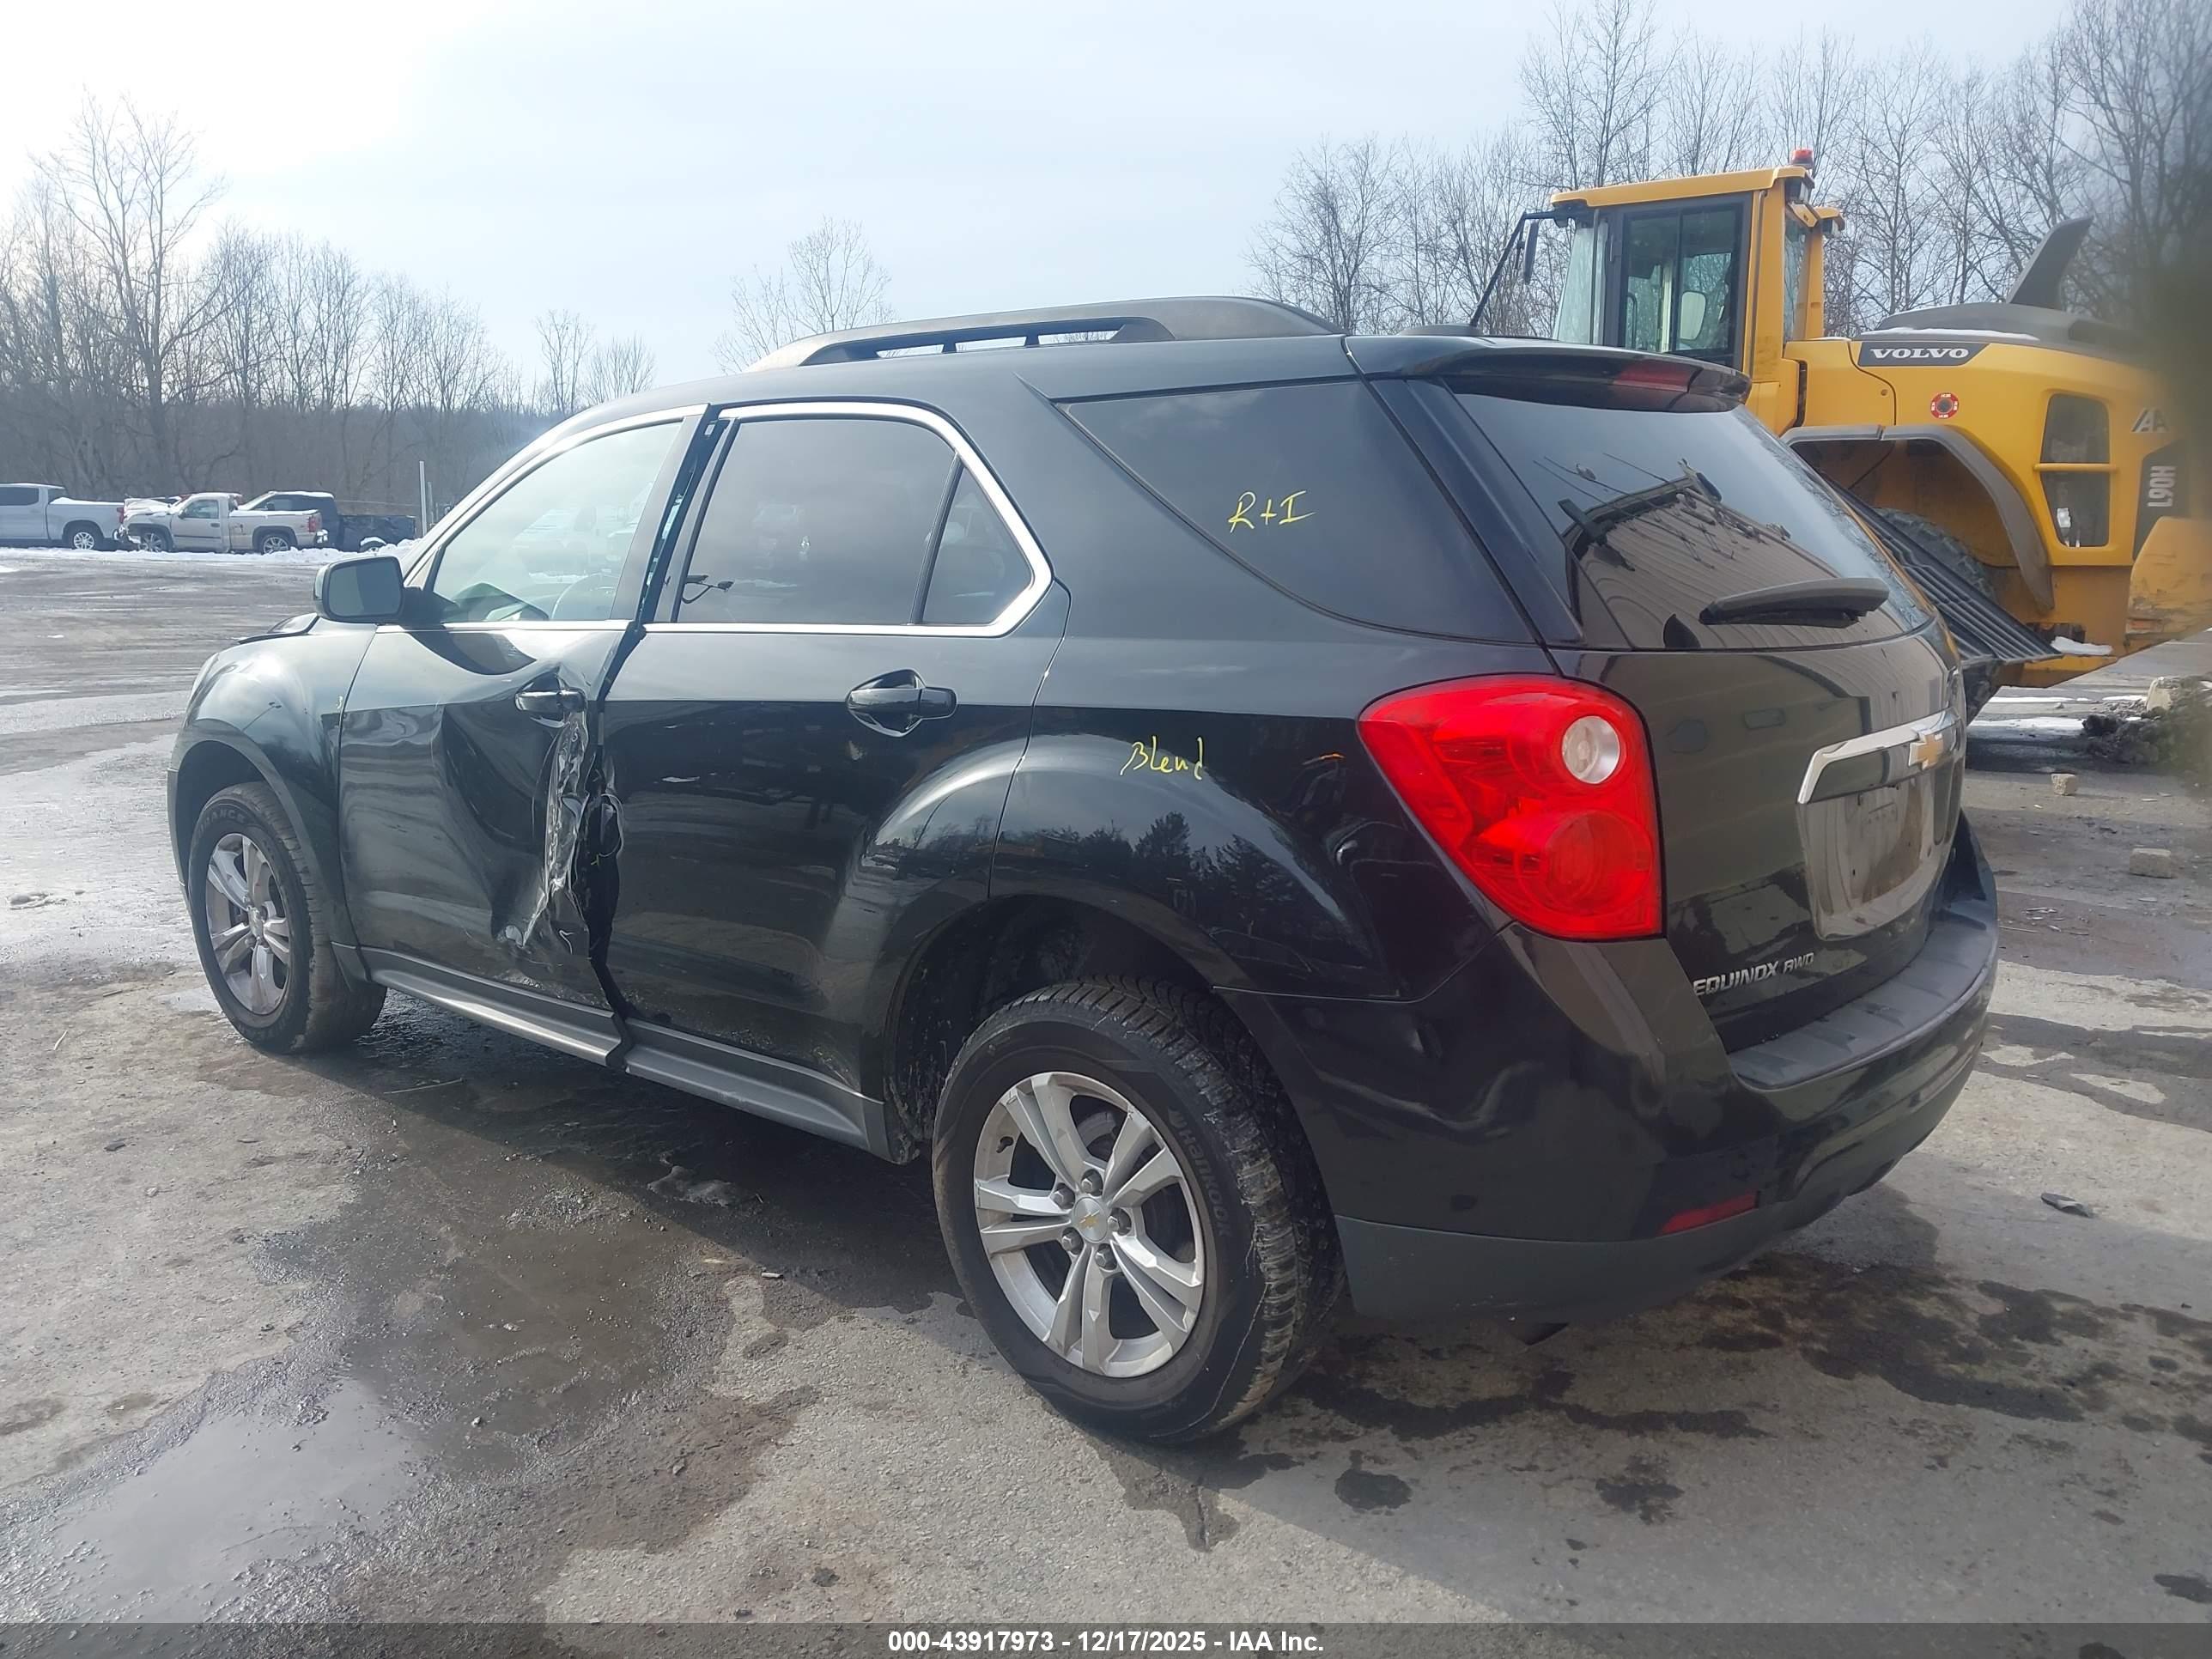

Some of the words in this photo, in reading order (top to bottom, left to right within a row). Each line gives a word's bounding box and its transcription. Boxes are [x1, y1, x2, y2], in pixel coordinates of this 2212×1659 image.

[1870, 348, 1969, 359] VOLVO
[2147, 465, 2177, 507] L90H
[1228, 489, 1317, 533] R+I
[1120, 735, 1203, 781] Blend
[1692, 961, 1778, 996] EQUINOX
[1782, 952, 1814, 974] AWD
